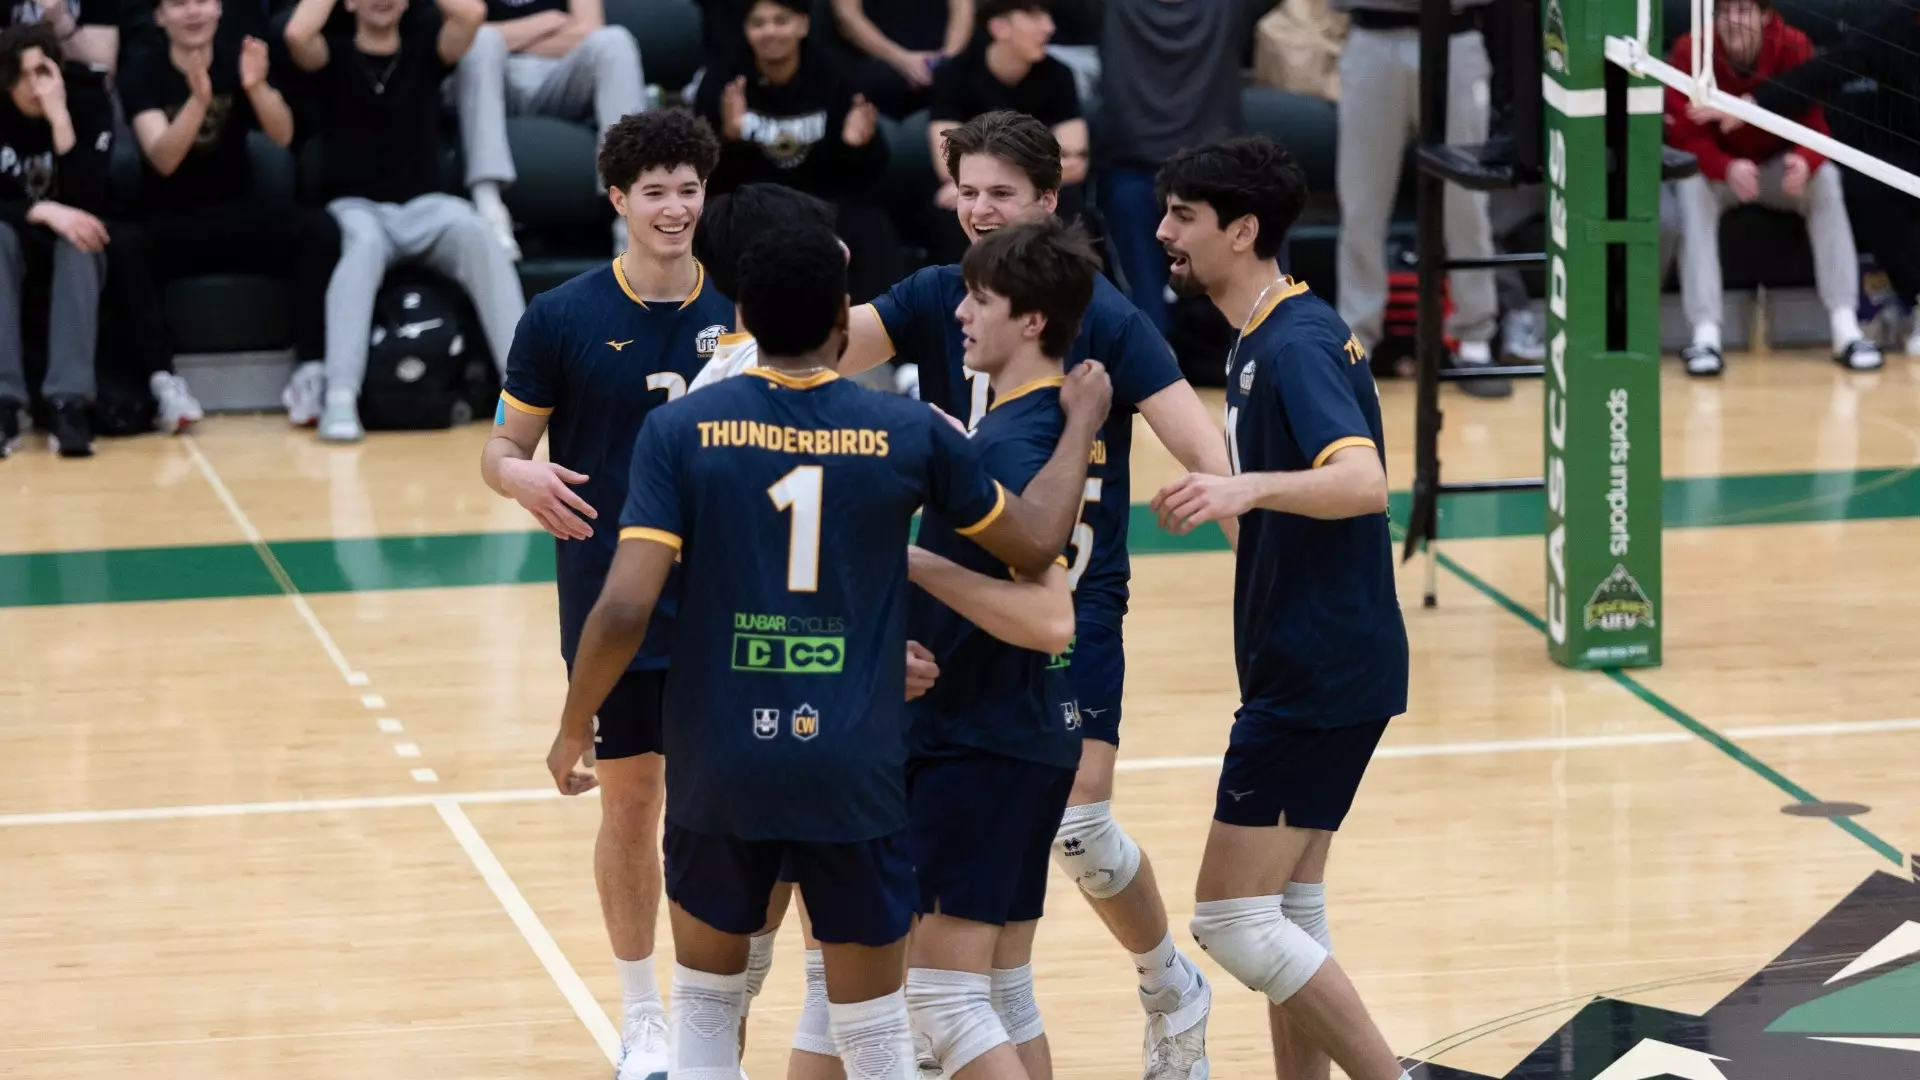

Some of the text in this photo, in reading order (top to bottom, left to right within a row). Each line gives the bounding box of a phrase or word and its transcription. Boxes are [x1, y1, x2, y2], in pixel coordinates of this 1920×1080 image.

[1548, 127, 1568, 646] CASCADES
[697, 420, 889, 457] THUNDERBIRDS
[1605, 388, 1631, 556] sports imports
[767, 465, 823, 592] 1
[734, 612, 845, 633] DUNBAR CYCLES
[795, 716, 816, 734] CW
